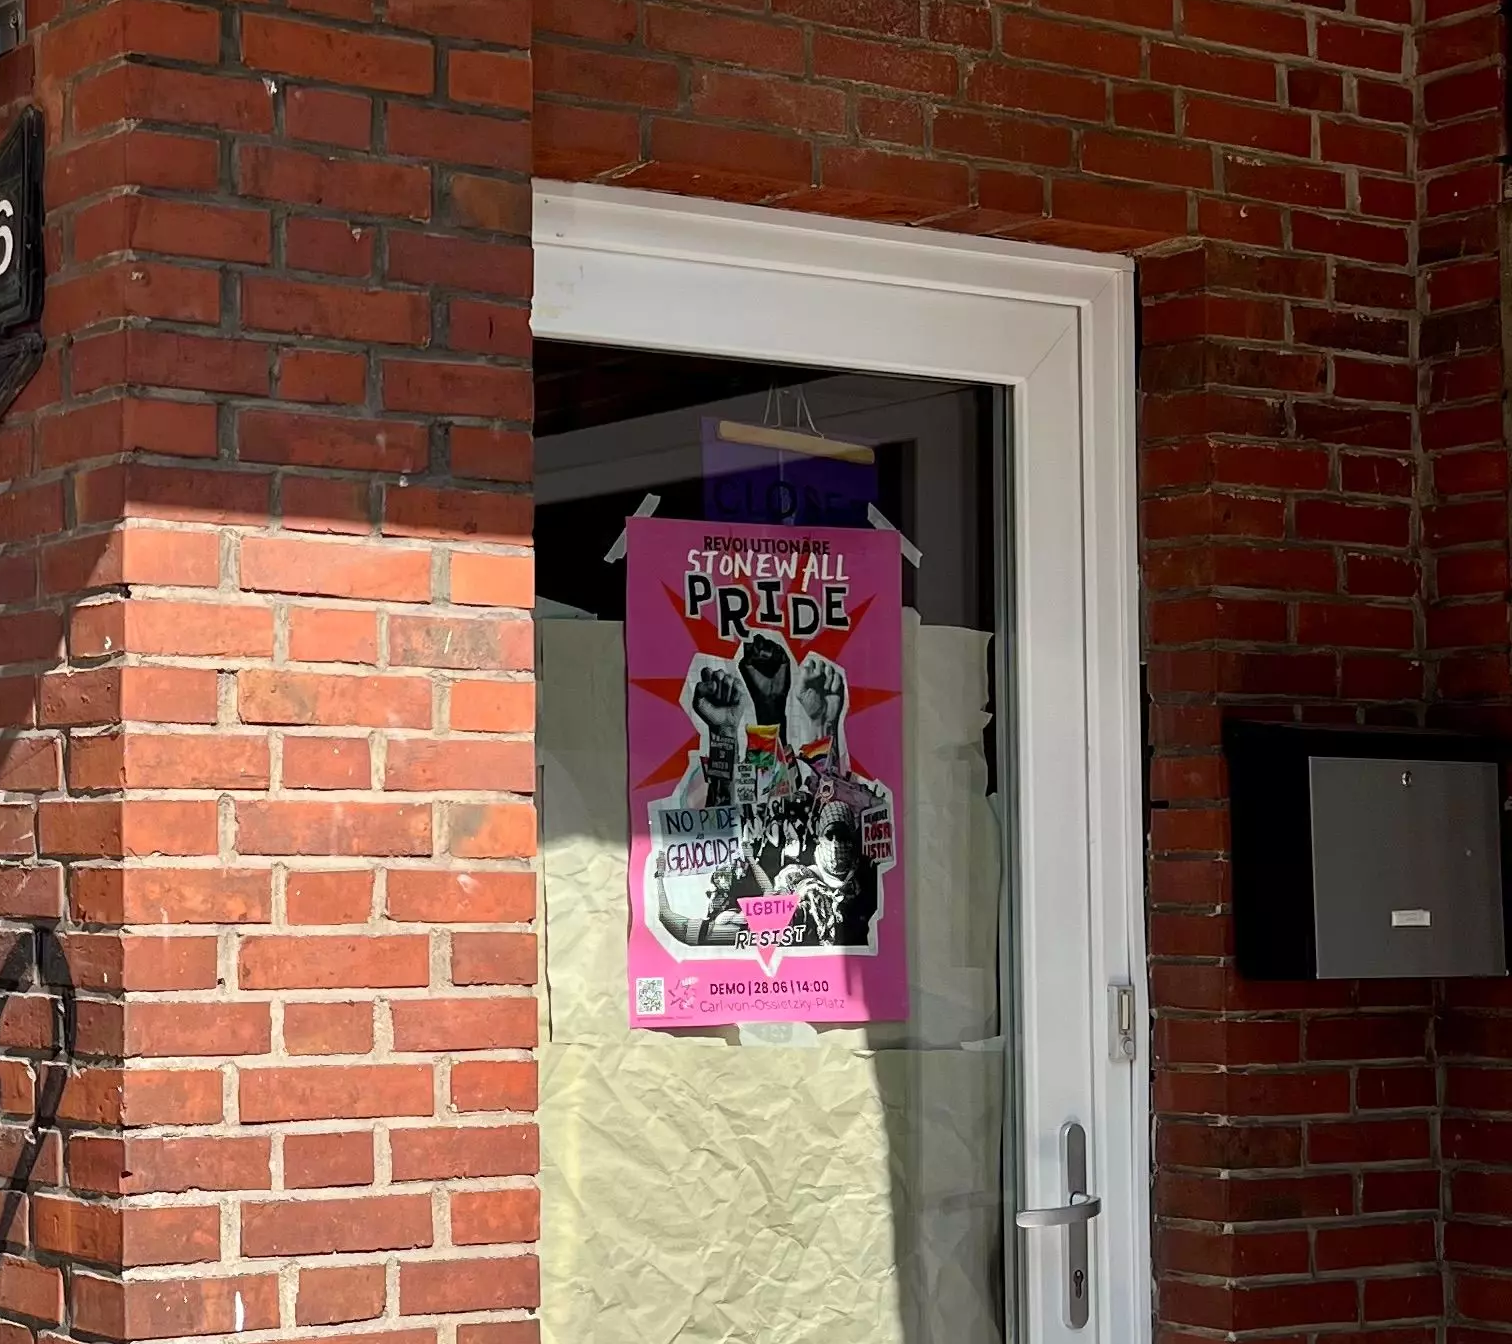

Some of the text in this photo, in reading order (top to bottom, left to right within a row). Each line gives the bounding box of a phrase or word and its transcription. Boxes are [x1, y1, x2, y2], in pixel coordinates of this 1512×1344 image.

[703, 536, 830, 555] REVOLUTIONÄRE
[687, 549, 850, 592] STONEWALL
[686, 572, 850, 640] PRIDE
[665, 808, 738, 835] NO PRIDE
[667, 837, 739, 872] GENOCIDE
[745, 899, 795, 917] LGBTI+
[736, 925, 807, 949] RESIST
[710, 982, 745, 995] DEMO
[754, 981, 788, 994] 28.06
[797, 980, 829, 993] 14:00
